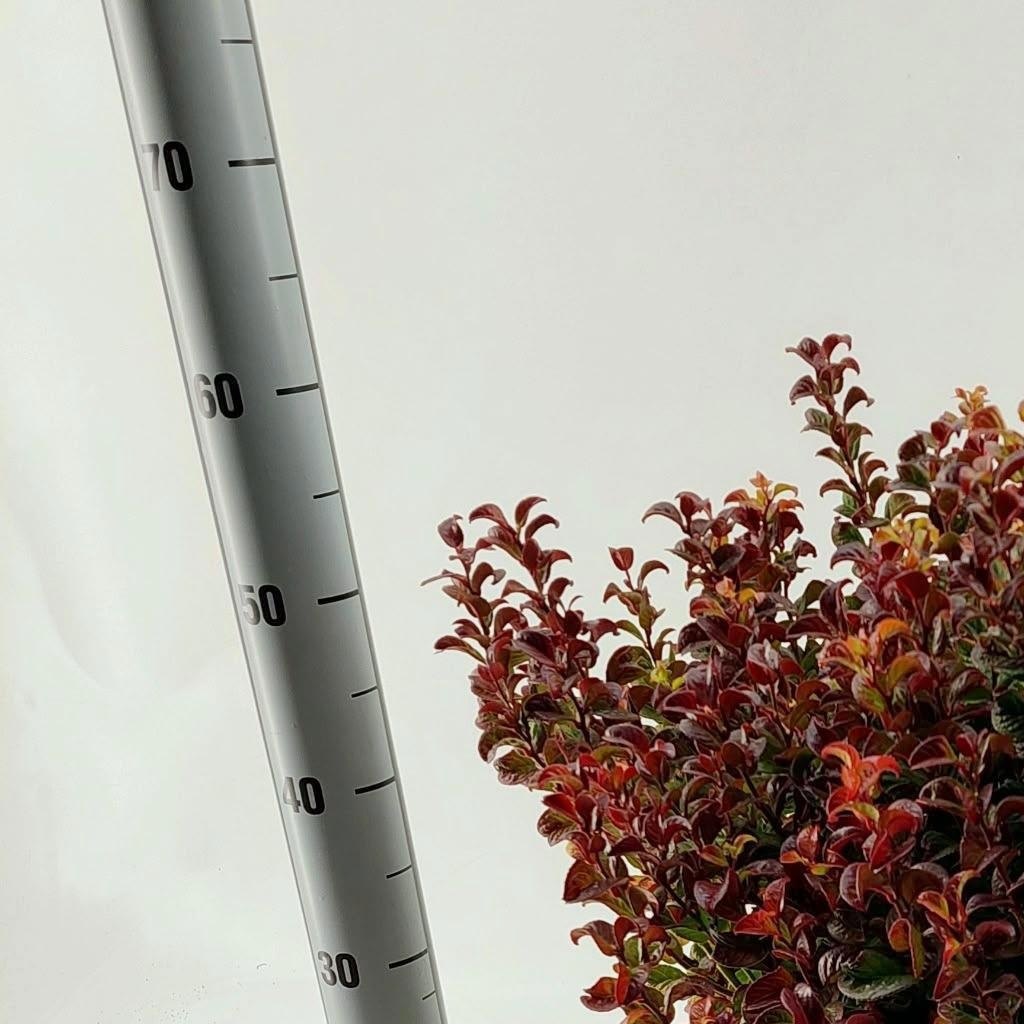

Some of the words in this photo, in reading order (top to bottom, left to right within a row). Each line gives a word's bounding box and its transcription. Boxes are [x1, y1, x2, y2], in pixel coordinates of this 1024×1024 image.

[141, 141, 194, 192] 70
[194, 372, 244, 419] 60
[237, 584, 287, 627] 50
[282, 776, 326, 815] 40
[317, 951, 360, 989] 30
